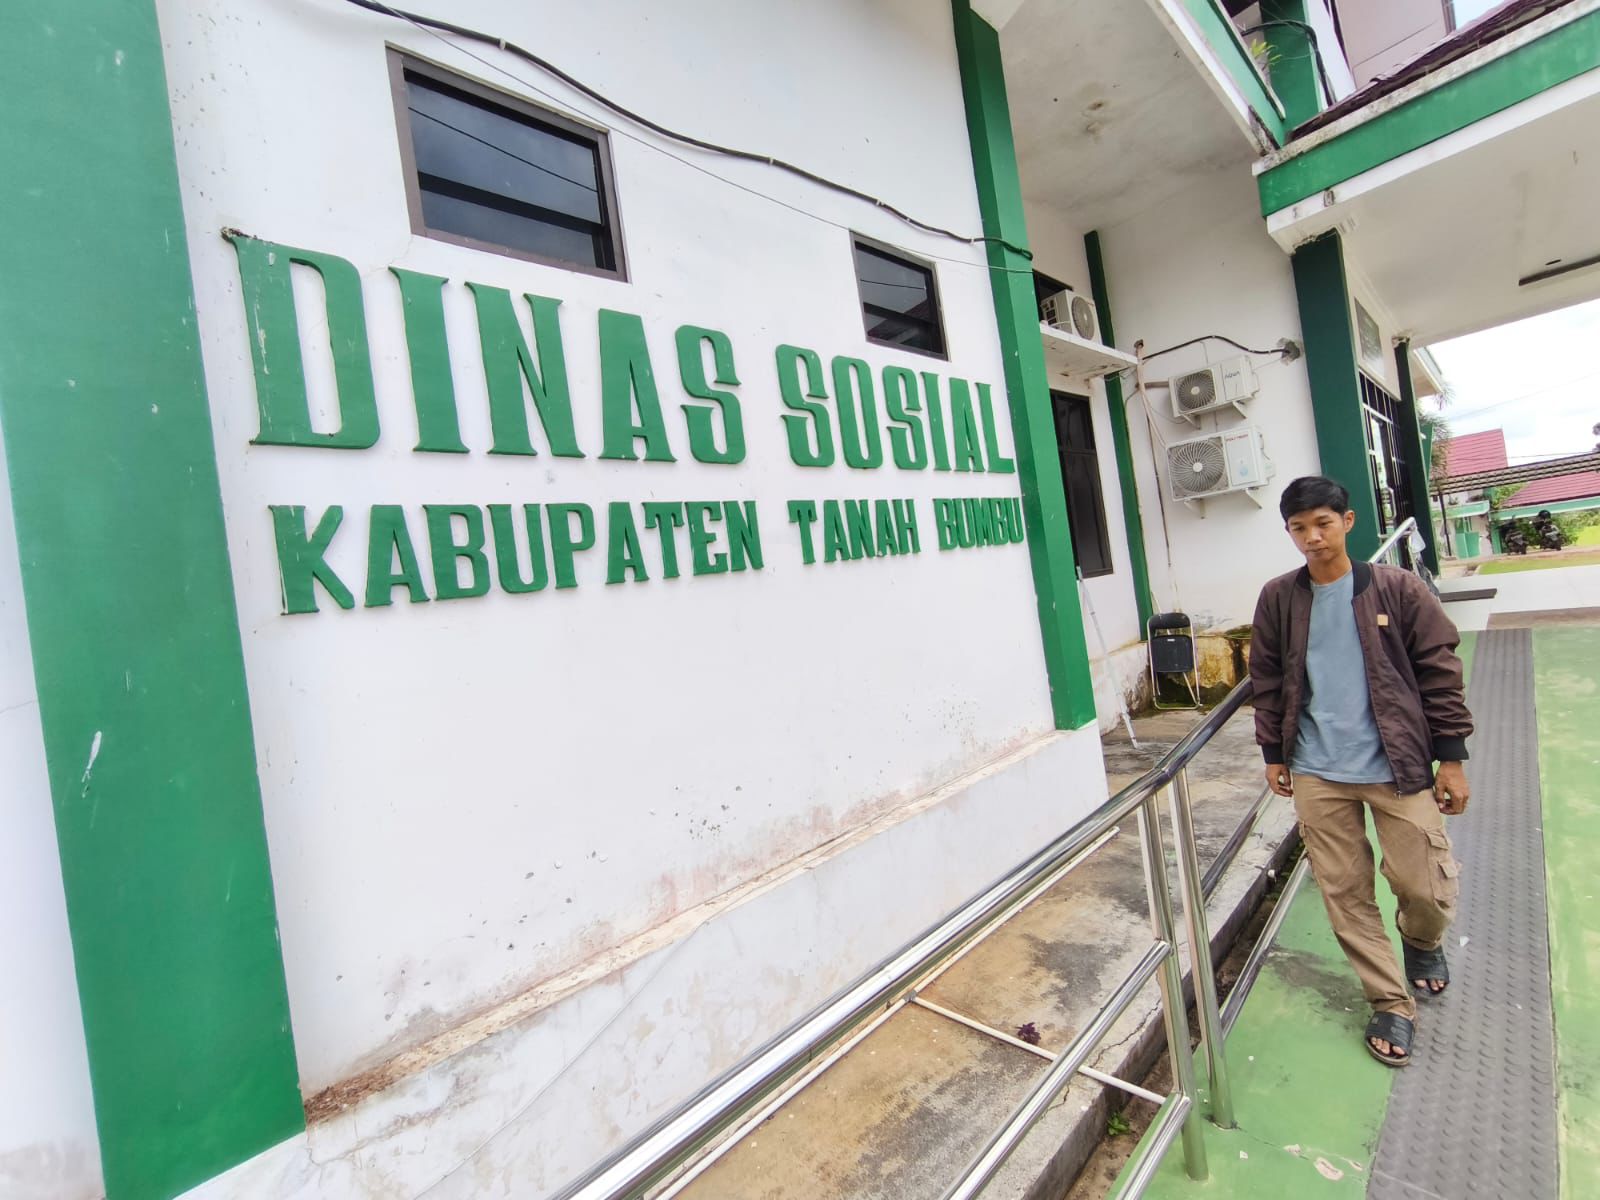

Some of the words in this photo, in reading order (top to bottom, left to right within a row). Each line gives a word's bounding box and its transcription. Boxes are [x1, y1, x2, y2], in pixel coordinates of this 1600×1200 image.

[226, 235, 747, 466] DINAS
[775, 344, 1016, 474] SOSIAL
[268, 500, 765, 615] KABUPATEN
[787, 499, 921, 565] TANAH
[932, 496, 1025, 551] BUMBU
